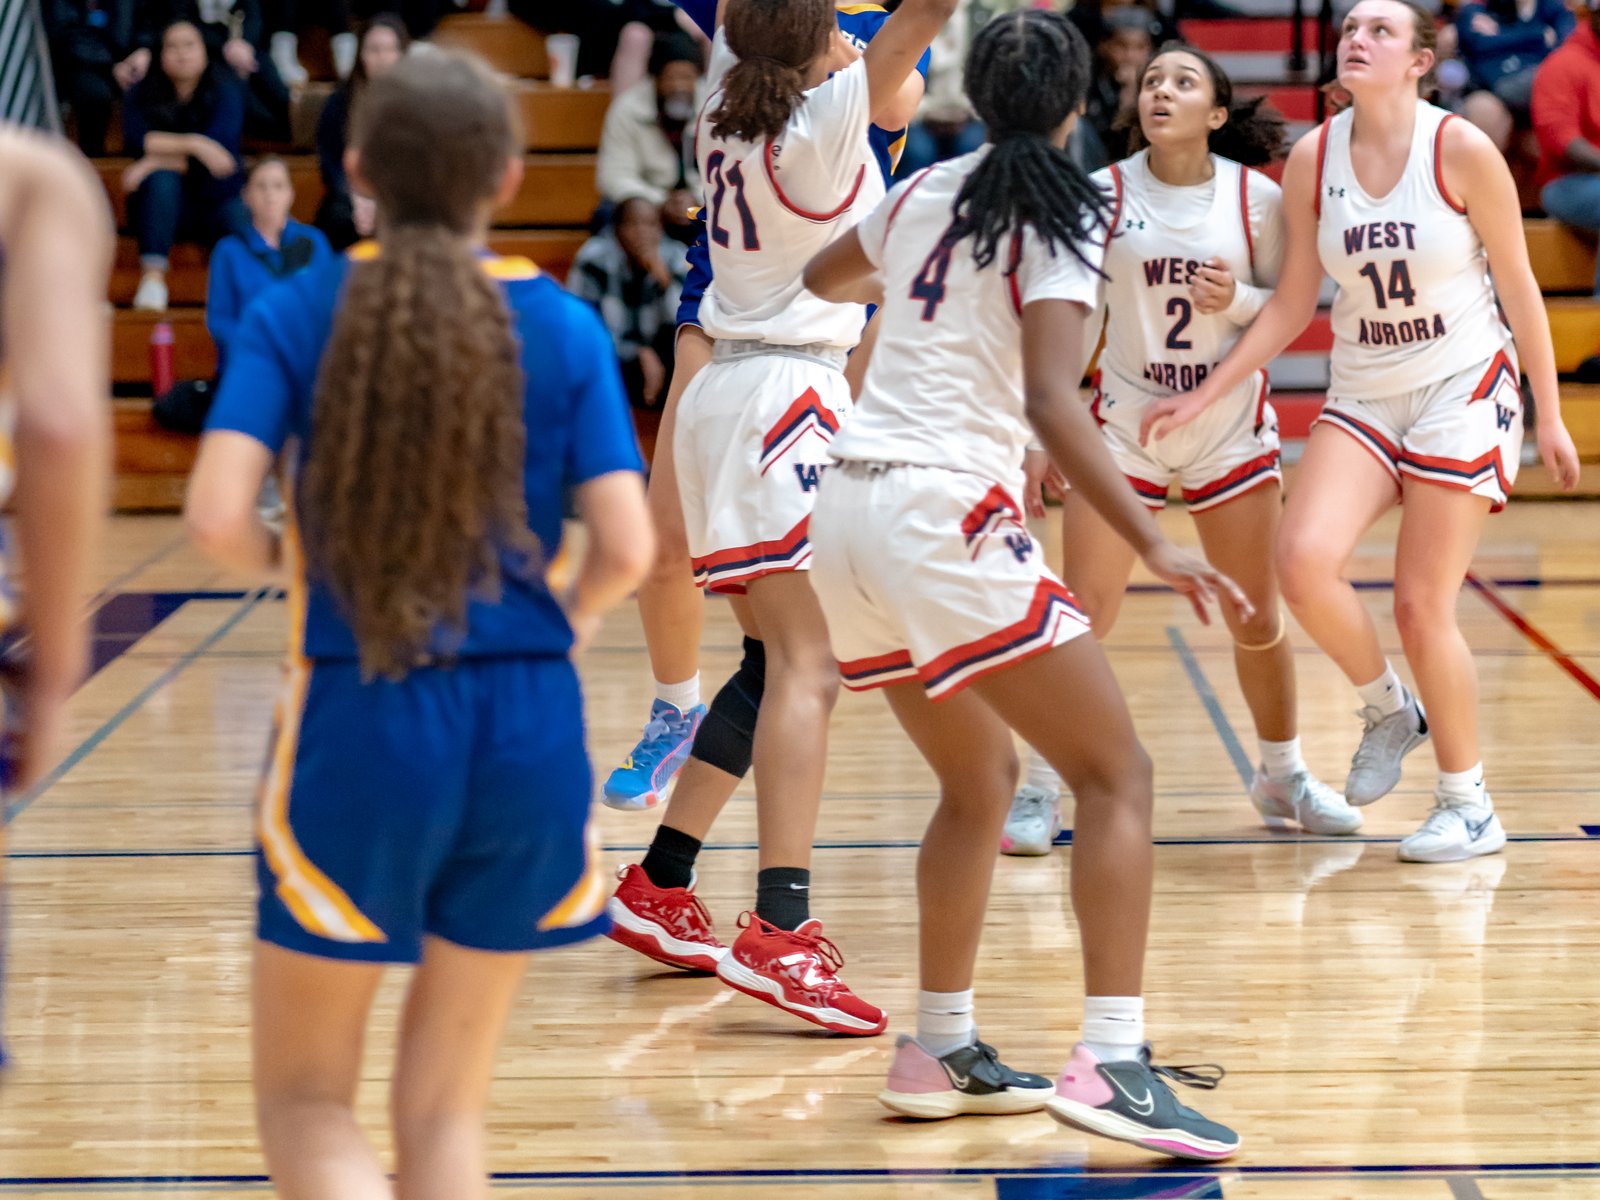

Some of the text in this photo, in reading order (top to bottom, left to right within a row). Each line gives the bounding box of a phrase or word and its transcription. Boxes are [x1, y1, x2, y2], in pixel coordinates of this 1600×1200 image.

[706, 149, 761, 251] 21
[1344, 221, 1416, 255] WEST
[908, 215, 971, 322] 4
[1143, 257, 1218, 287] WES
[1359, 259, 1416, 310] 14
[1166, 297, 1193, 350] 2
[1359, 313, 1446, 346] AURORA
